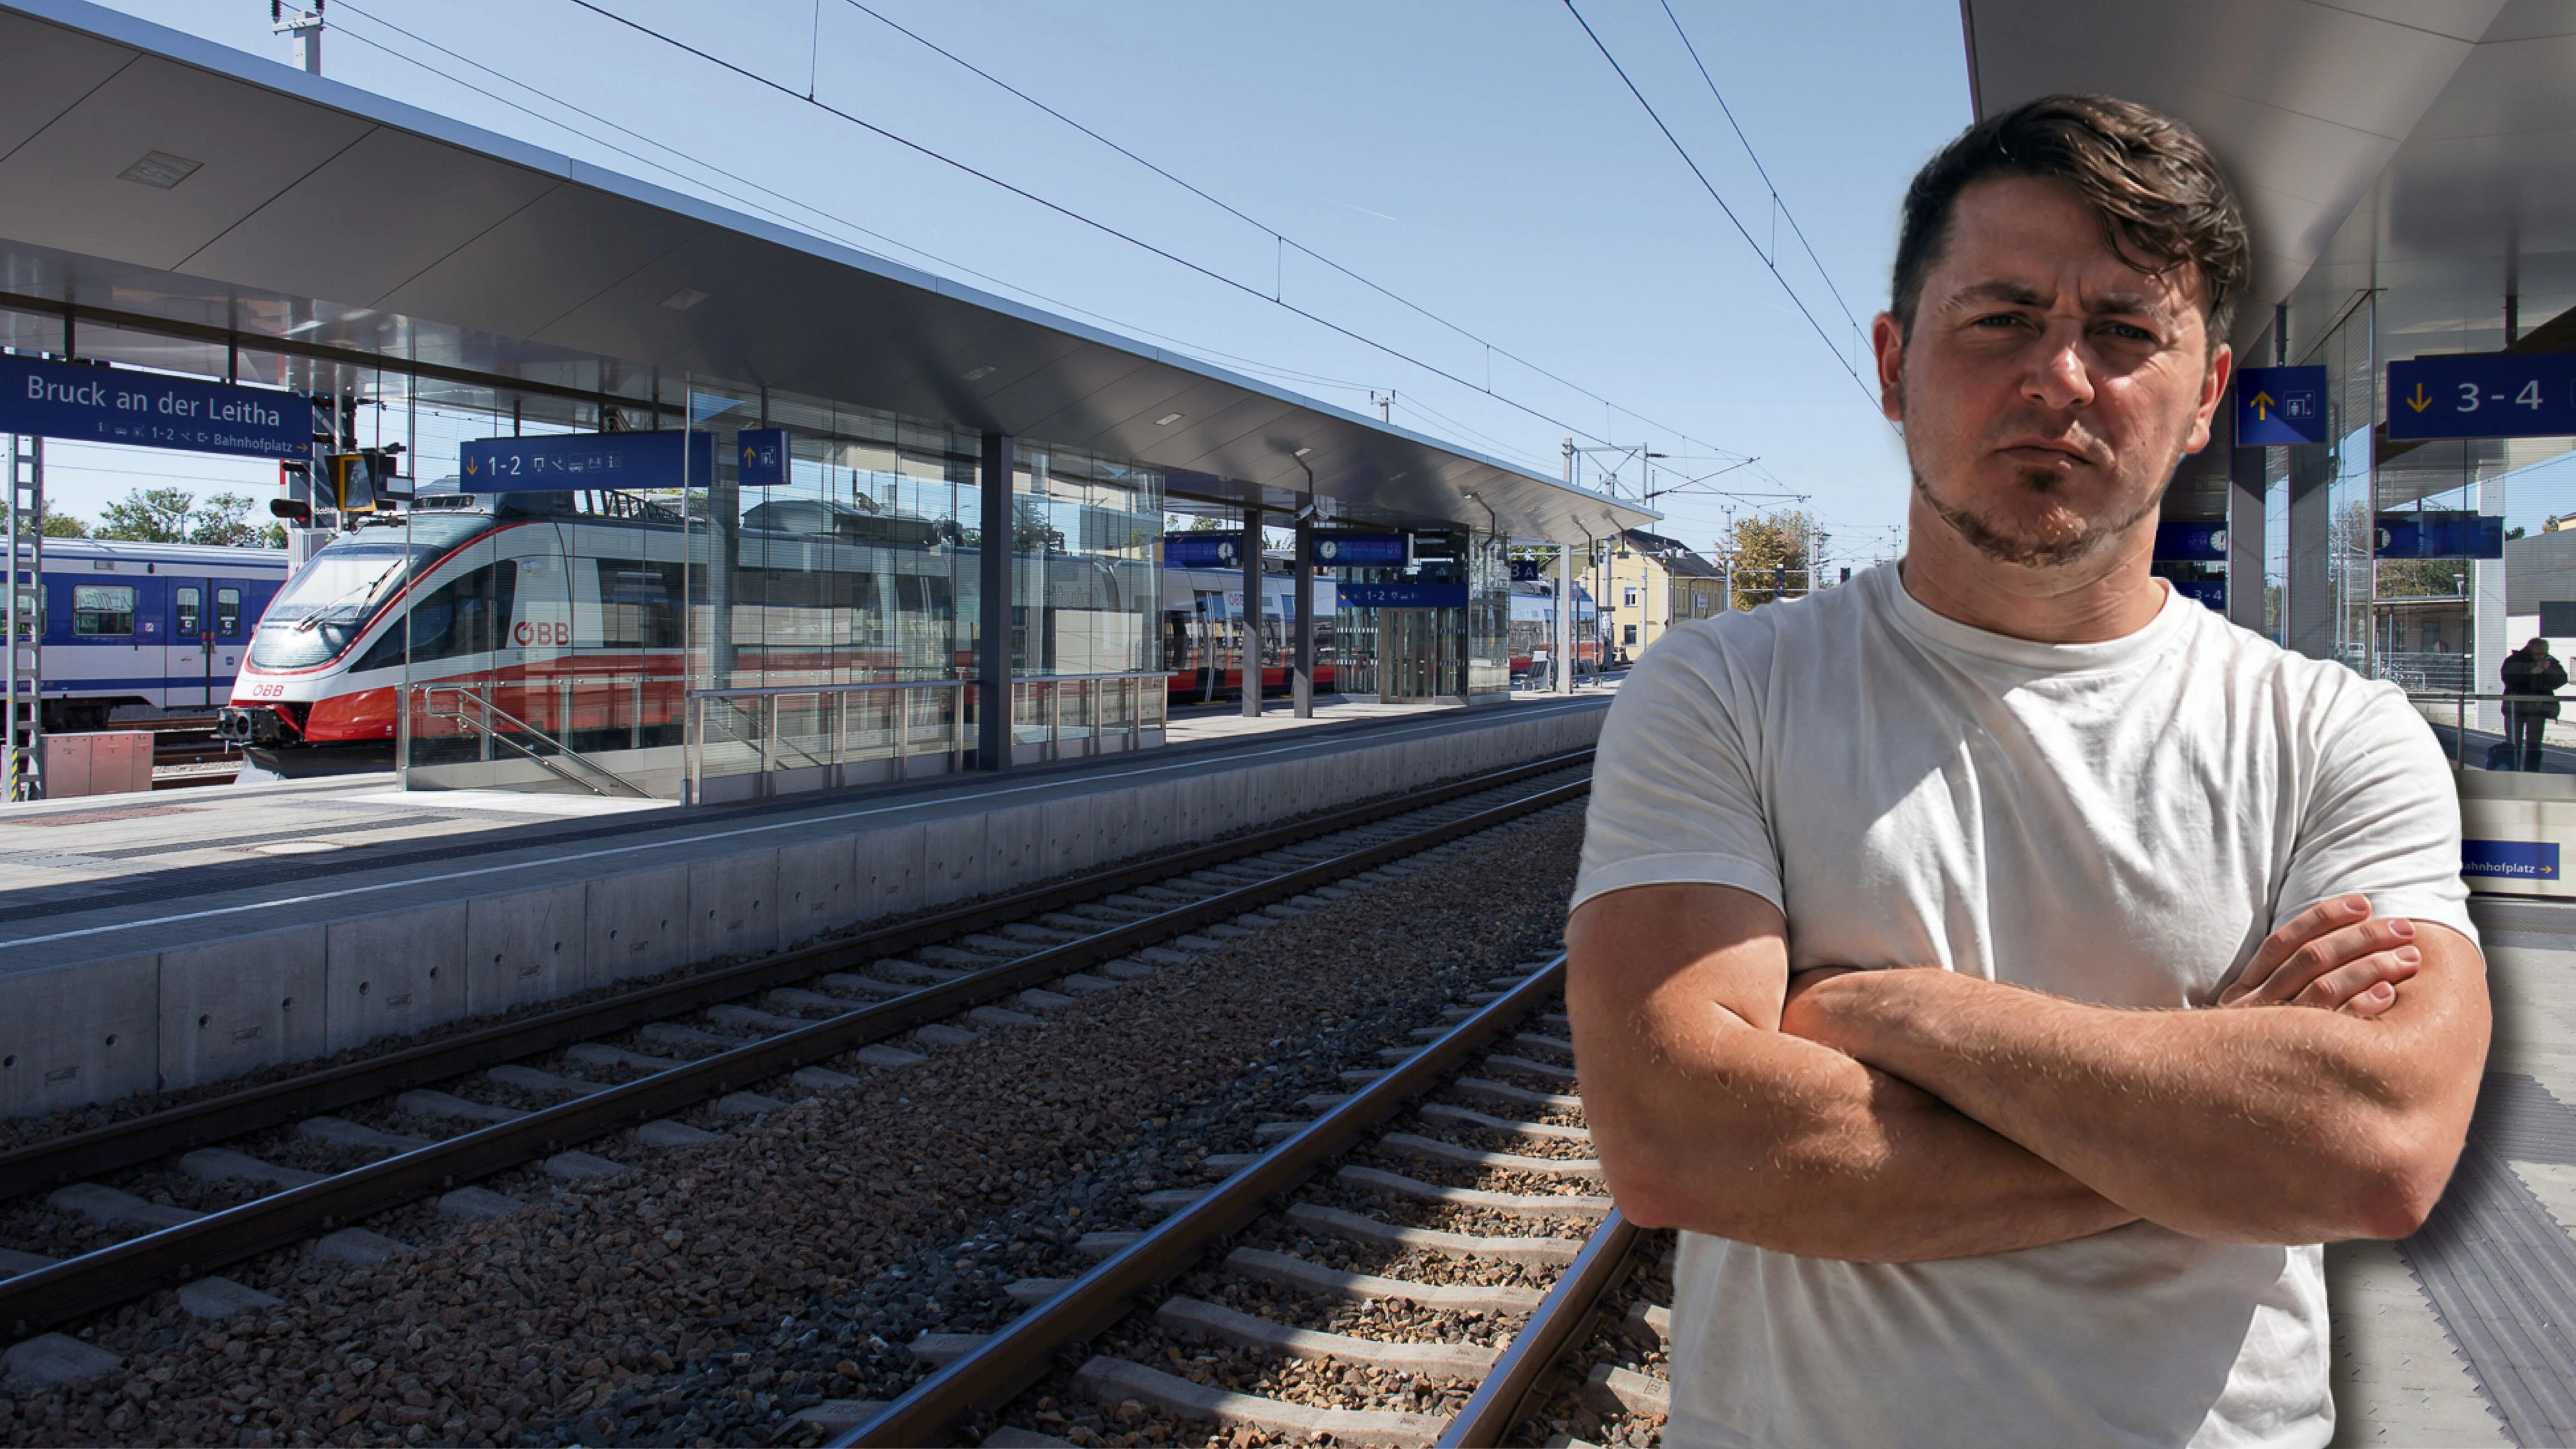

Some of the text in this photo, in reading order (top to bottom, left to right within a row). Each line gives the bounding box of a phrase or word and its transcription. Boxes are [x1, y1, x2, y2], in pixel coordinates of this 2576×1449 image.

[27, 374, 281, 428] Bruck an der Leitha
[151, 426, 293, 454] 1-2 Bahnhofplatz
[488, 455, 522, 477] 1-2
[1524, 567, 1534, 578] A
[1366, 591, 1385, 601] 1-2
[513, 620, 570, 647] ÖBB
